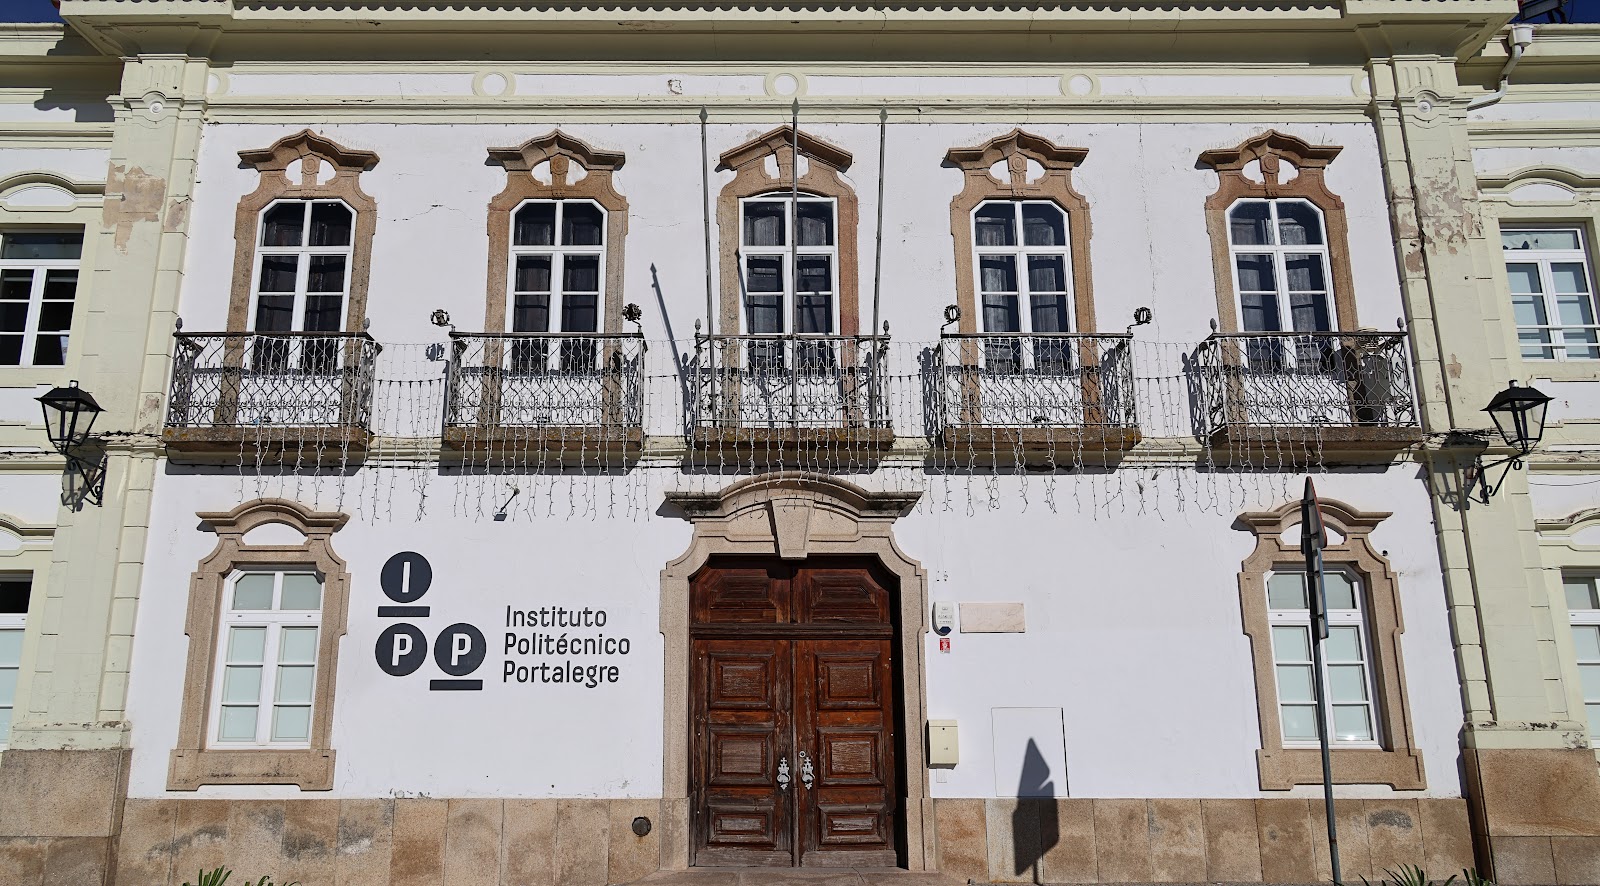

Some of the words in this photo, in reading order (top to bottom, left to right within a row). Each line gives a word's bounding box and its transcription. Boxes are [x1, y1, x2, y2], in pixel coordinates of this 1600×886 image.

[401, 561, 411, 593] I
[506, 605, 607, 627] Instituto
[504, 633, 631, 655] Politécnico
[503, 661, 619, 688] Portalegre
